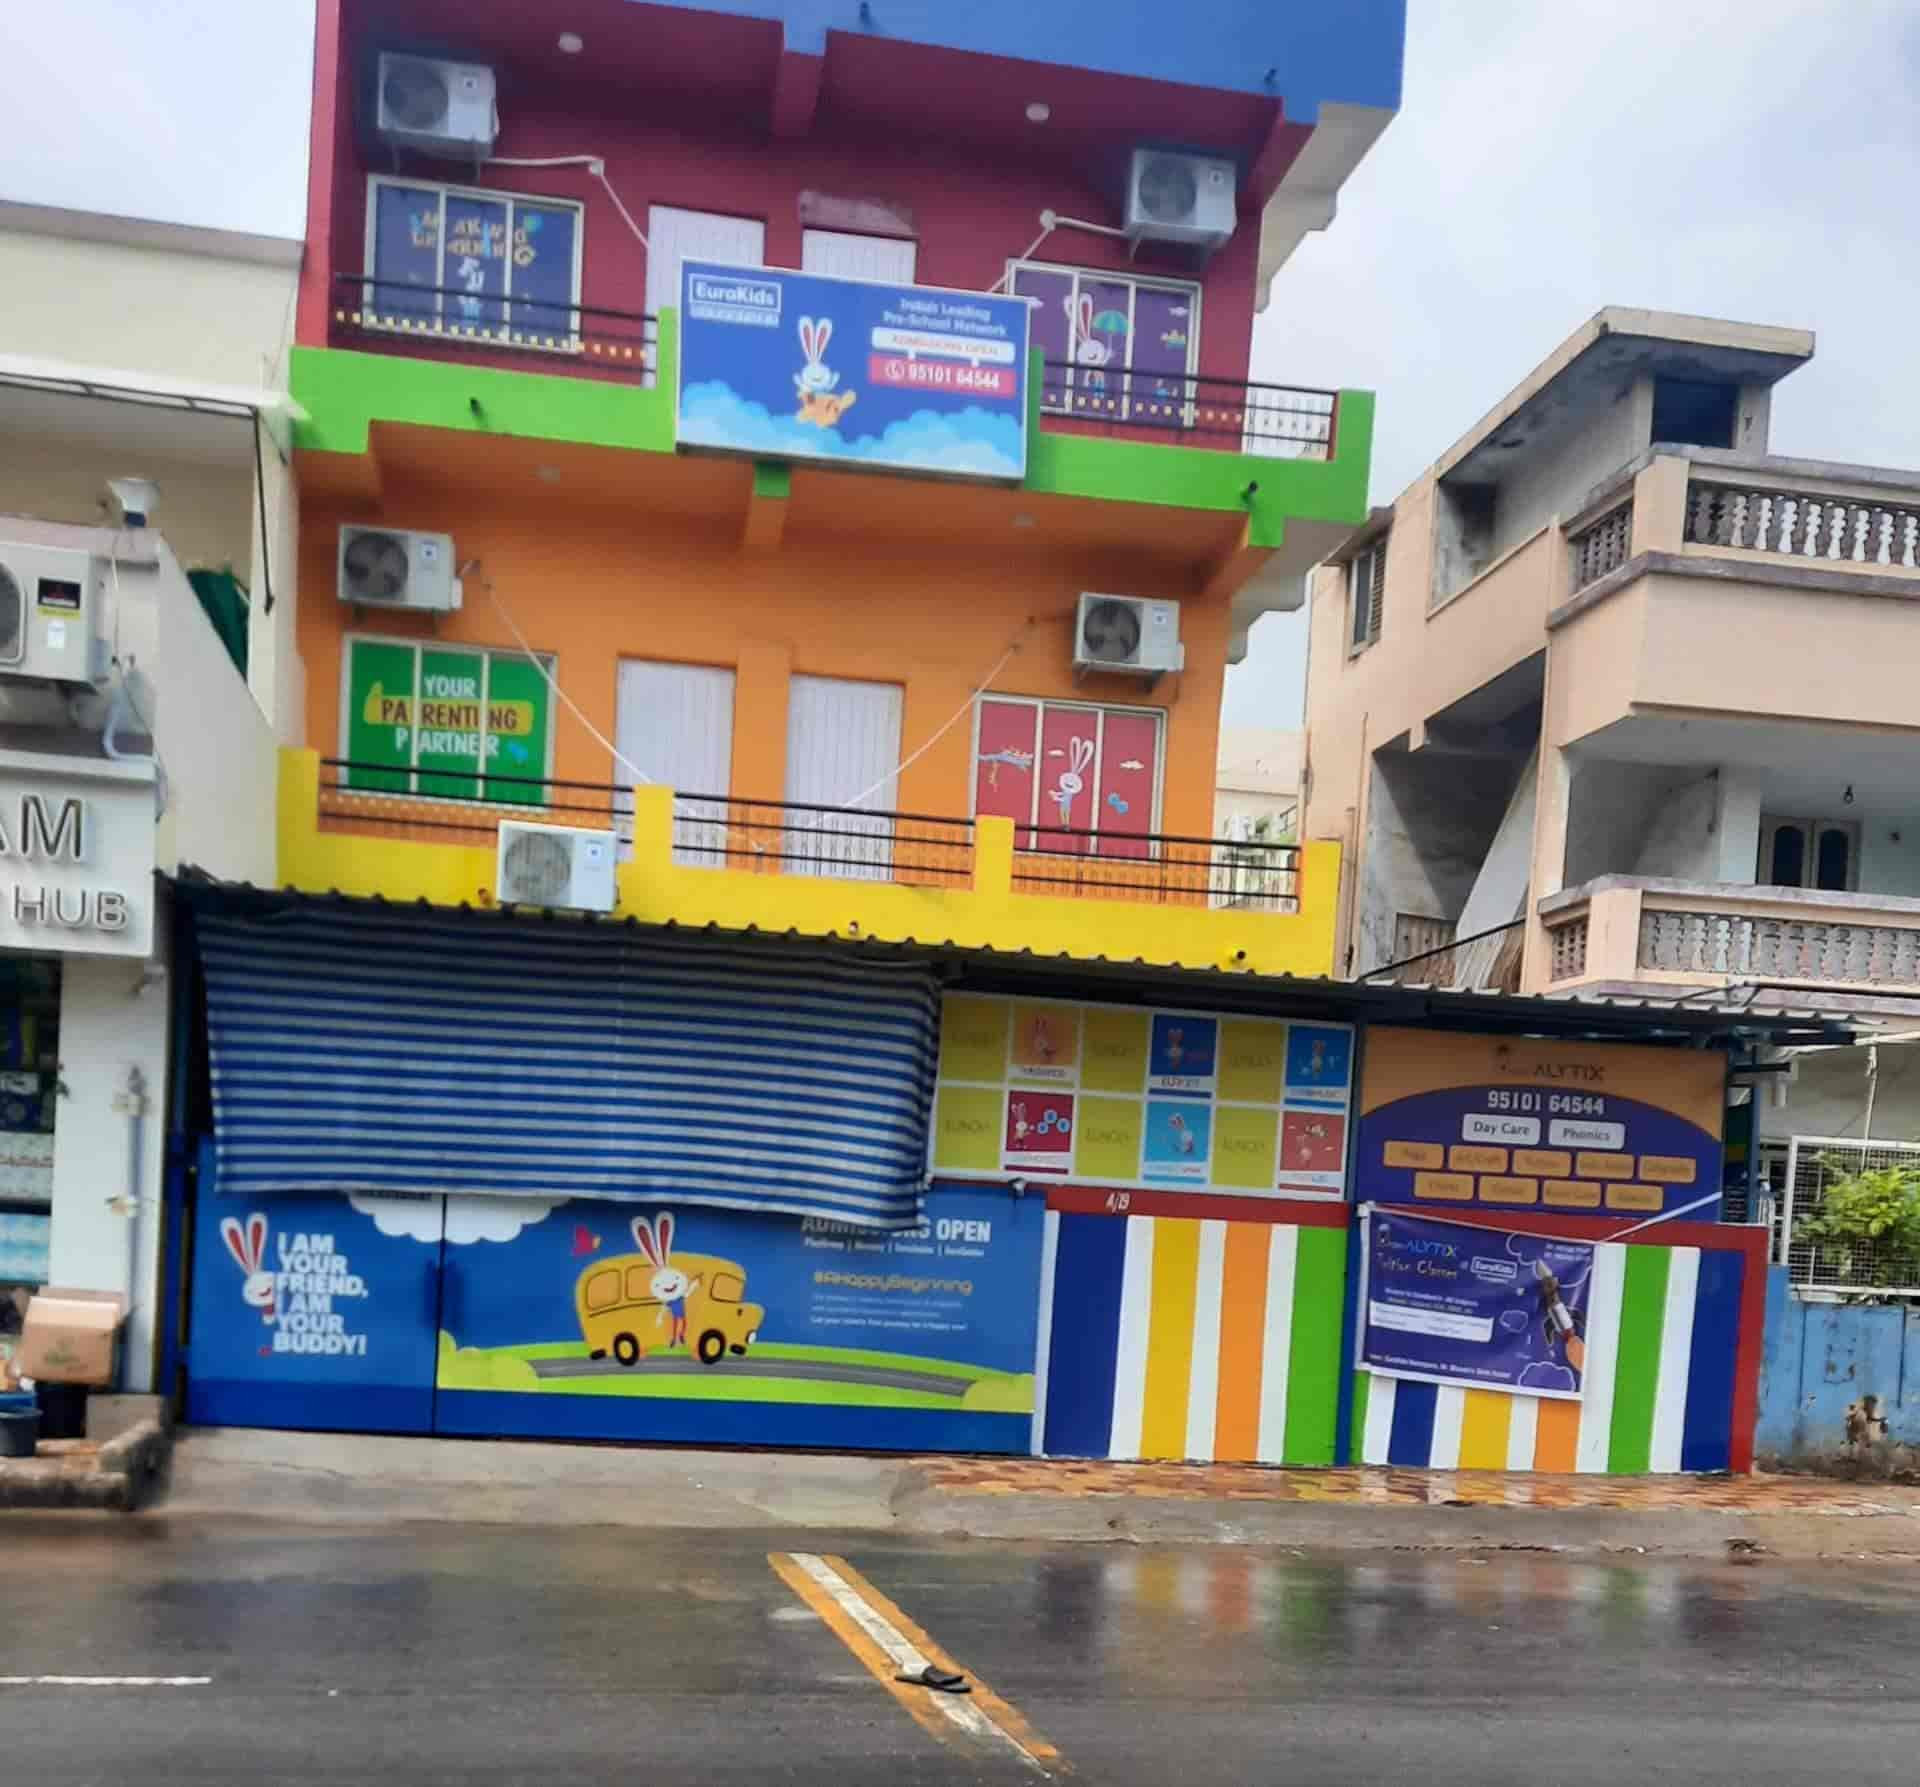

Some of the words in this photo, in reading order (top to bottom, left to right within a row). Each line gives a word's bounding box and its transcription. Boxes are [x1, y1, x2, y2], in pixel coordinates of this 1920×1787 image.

[695, 280, 774, 305] EuroKids
[423, 676, 477, 698] YOUR
[381, 699, 518, 730] PARENTING
[394, 727, 500, 757] PARTNER
[11, 884, 127, 930] HUB
[1487, 1090, 1541, 1112] 95101
[1548, 1095, 1605, 1116] 64544
[1473, 1120, 1499, 1135] Day
[1501, 1122, 1531, 1137] Care
[1562, 1126, 1612, 1142] Phonics
[277, 1231, 288, 1253] I
[291, 1233, 335, 1254] AM
[936, 1218, 992, 1243] OPEN
[278, 1251, 349, 1276] YOUR
[275, 1273, 369, 1299] FRIEND,
[290, 1294, 332, 1314] AM
[277, 1312, 345, 1335] YOUR
[272, 1332, 368, 1356] BUDDY!
